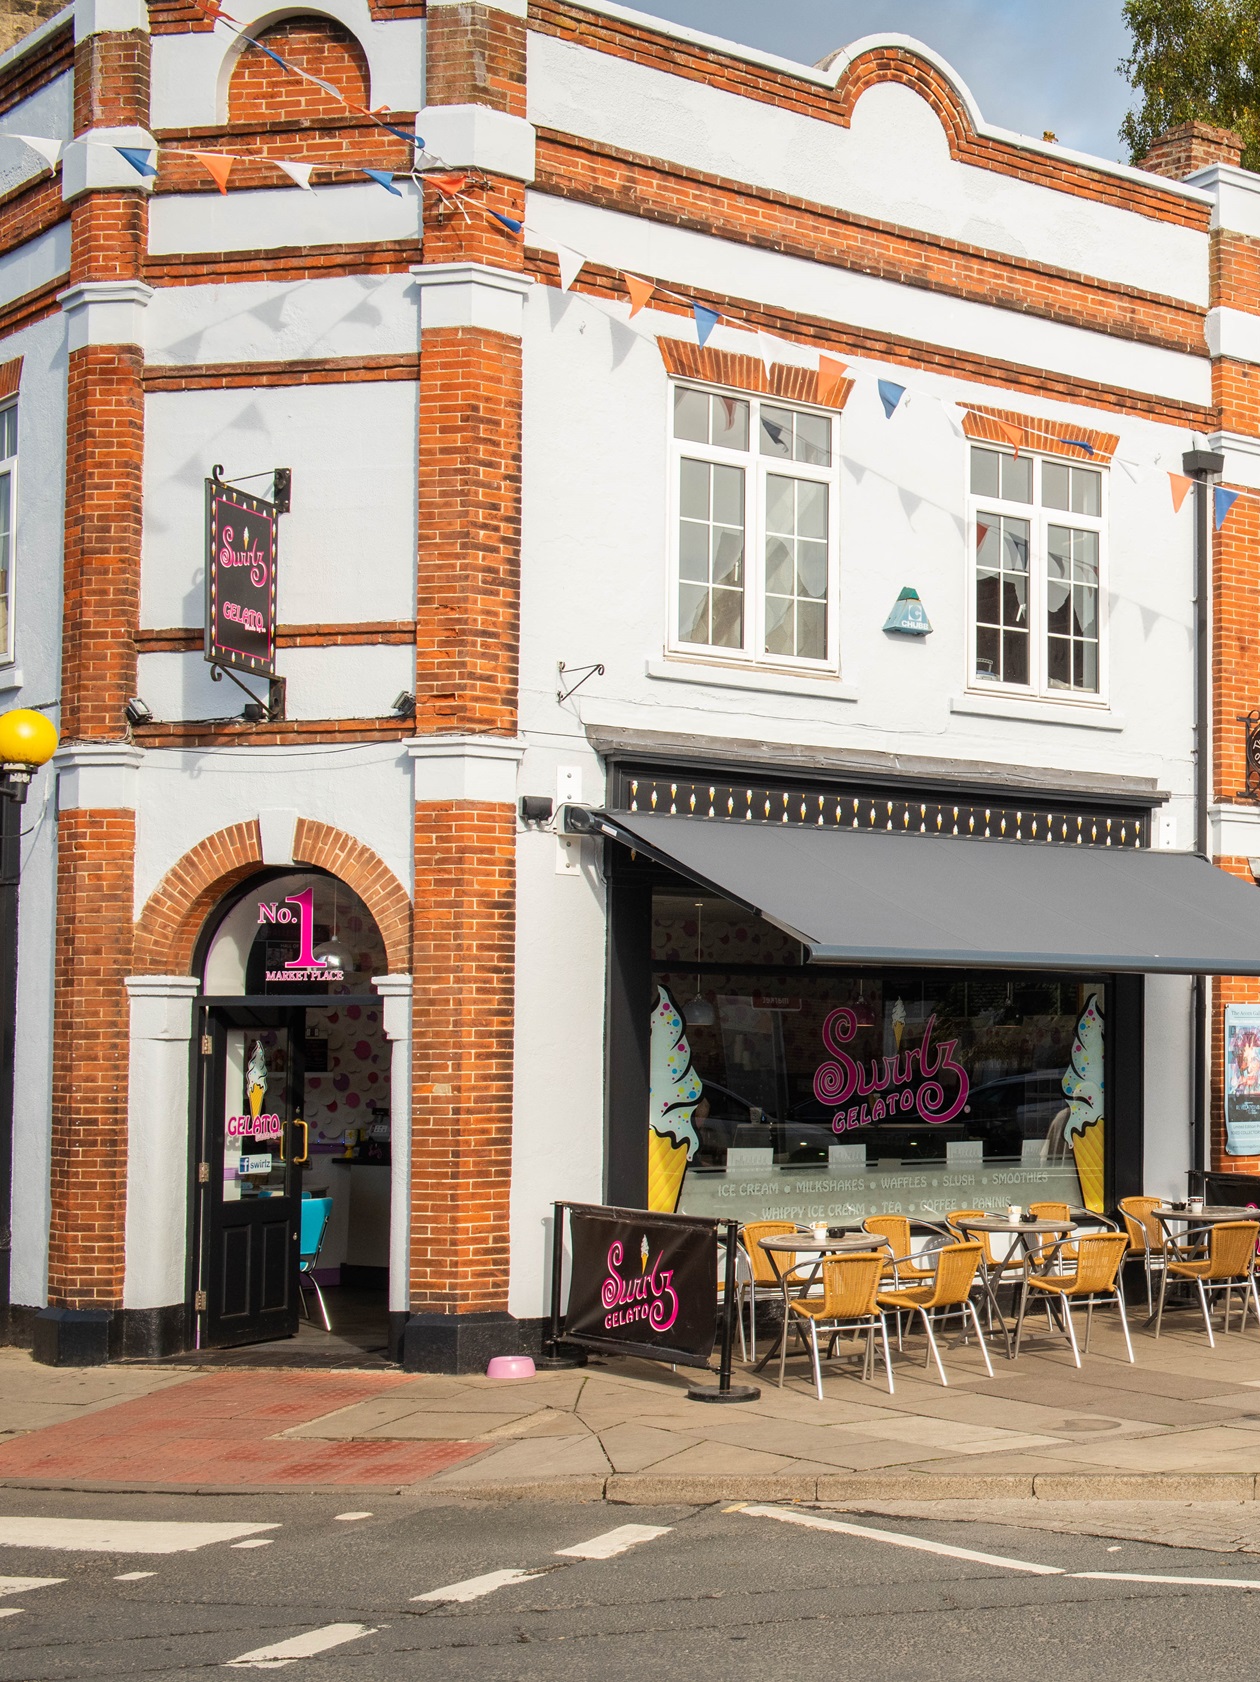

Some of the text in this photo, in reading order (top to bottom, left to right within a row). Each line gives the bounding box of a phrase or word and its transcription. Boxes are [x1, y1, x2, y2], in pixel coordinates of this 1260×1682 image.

[223, 601, 264, 629] GELATO
[902, 620, 929, 630] CHUBB
[257, 887, 328, 968] No. 1
[265, 970, 345, 981] MARKET PLACE
[227, 1113, 281, 1136] GELATO
[832, 1089, 915, 1135] GELATO
[250, 1159, 271, 1170] swirlz
[718, 1171, 1049, 1197] ICE CREAM MILKSHAKES WAFFLES SLUSH SMOOTHIES
[762, 1196, 1011, 1221] WHIPPY ICE CREAM TEA COFFEE PANINIS
[605, 1303, 650, 1330] GELATO
